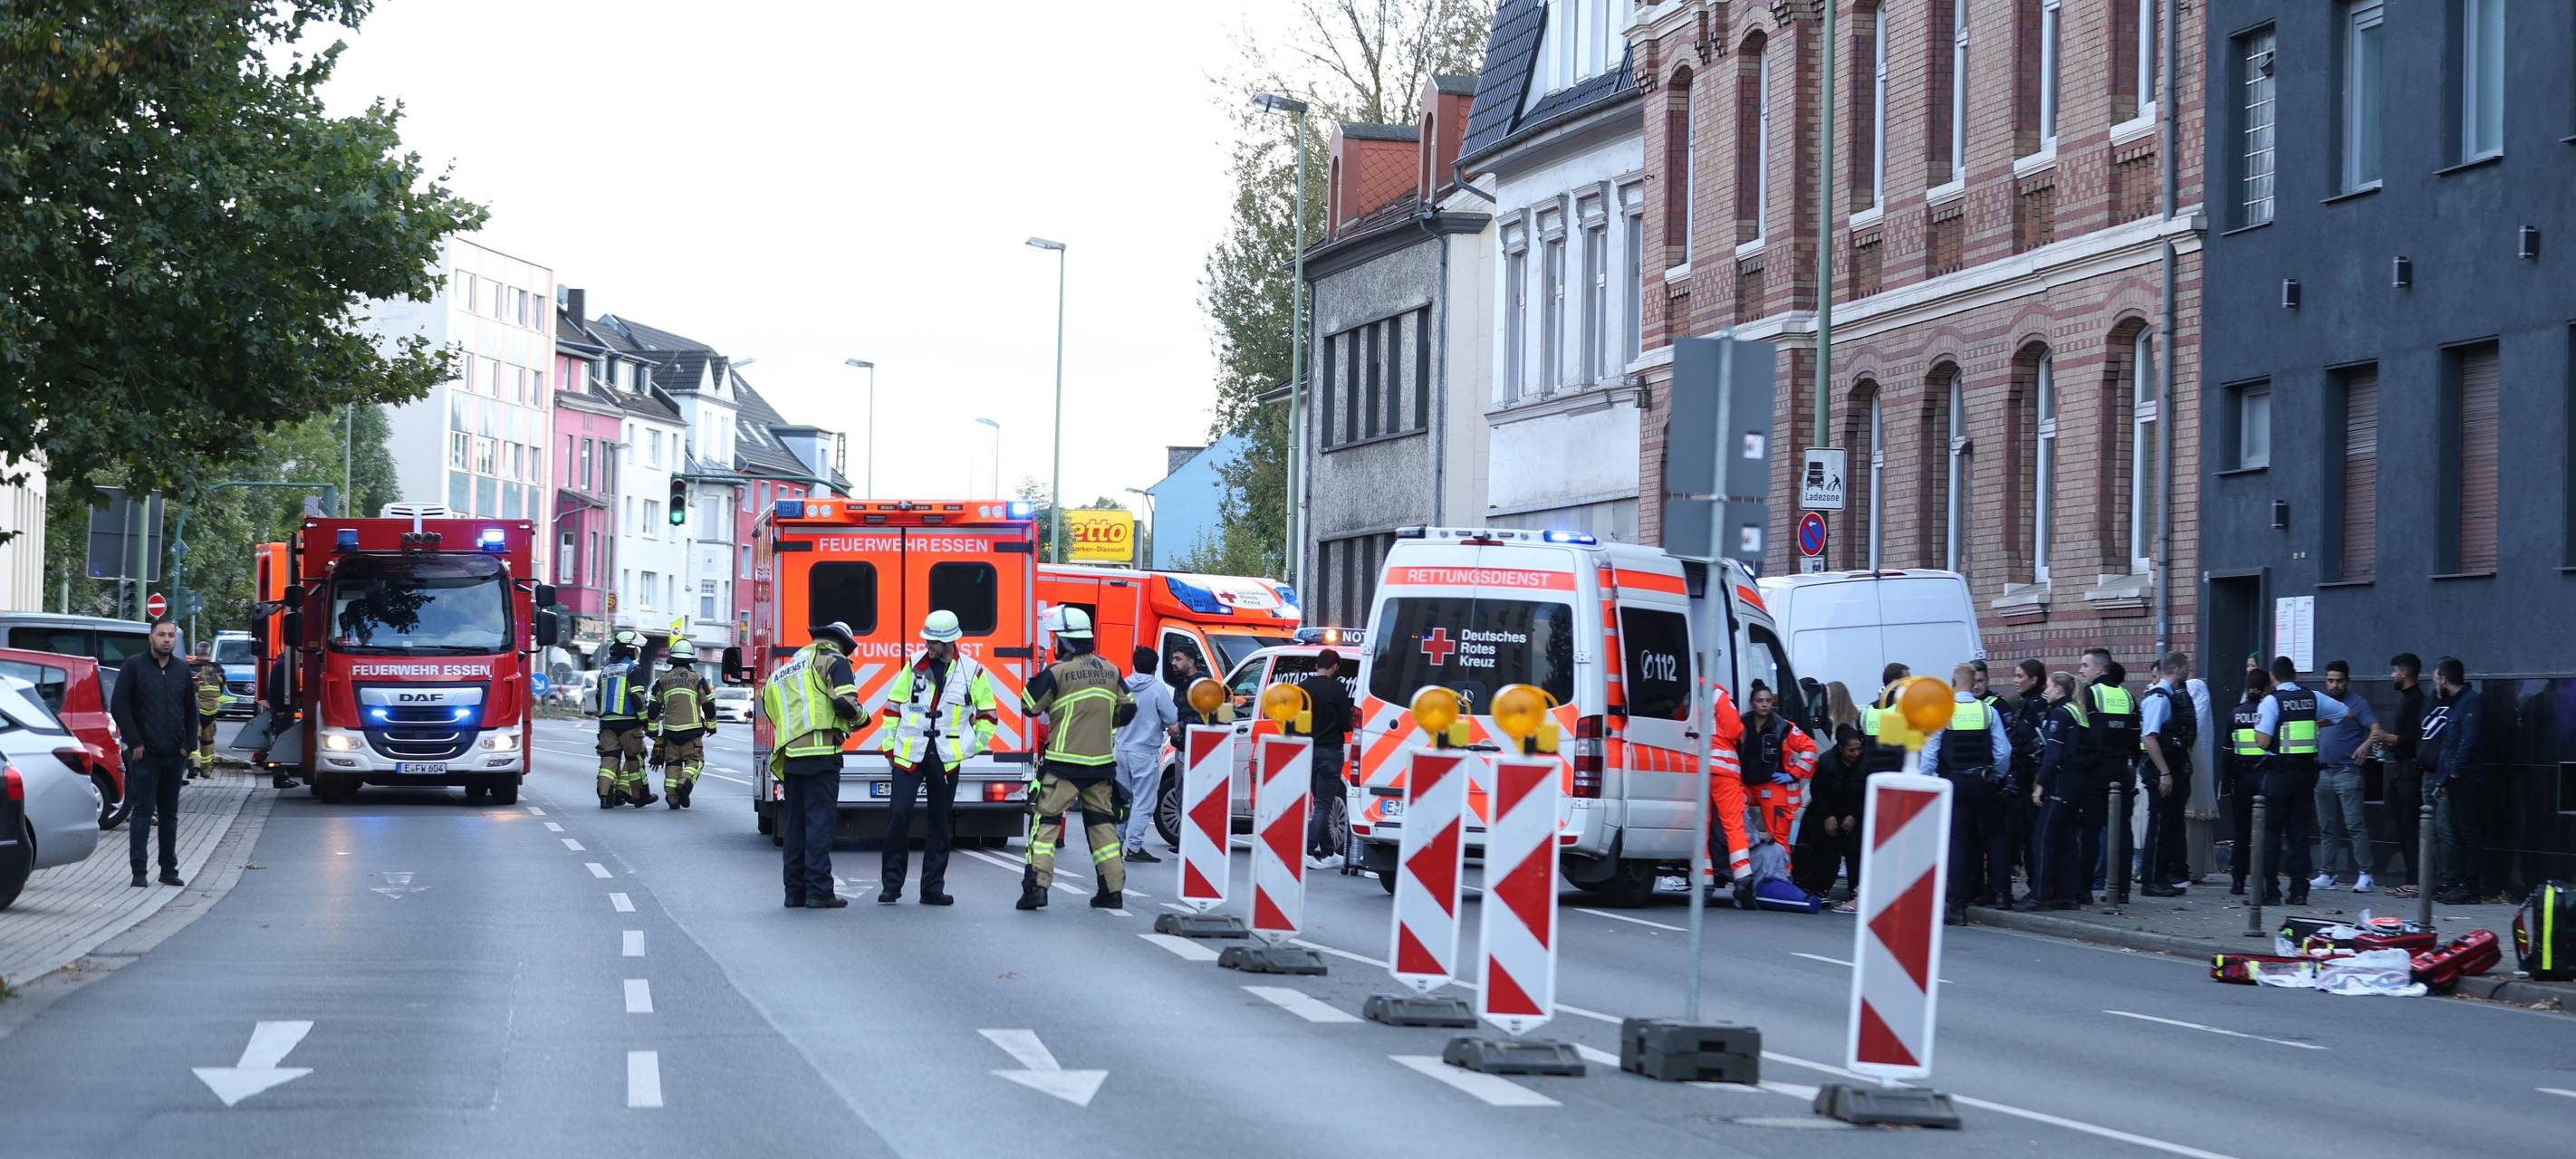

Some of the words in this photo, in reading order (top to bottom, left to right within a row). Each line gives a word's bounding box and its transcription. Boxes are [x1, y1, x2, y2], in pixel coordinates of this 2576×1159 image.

[1805, 492, 1841, 502] Ladezone
[1071, 519, 1128, 543] etto
[819, 537, 928, 552] FEUERWEHR
[930, 538, 988, 553] ESSEN
[1072, 545, 1125, 554] arken-Discount
[1407, 569, 1551, 587] RETTUNGSDIENST
[1342, 630, 1366, 643] NOT
[1462, 628, 1527, 644] Deutsches
[1460, 642, 1495, 655] Rotes
[1459, 655, 1495, 668] Kreuz
[1655, 653, 1677, 682] 112
[351, 665, 439, 675] FEUERWEHR
[443, 665, 491, 675] ESSEN
[773, 659, 807, 684] A-DIENST
[1064, 669, 1116, 683] FEUERWEHR
[399, 694, 444, 702] DAF
[2283, 699, 2315, 711] POLIZEI
